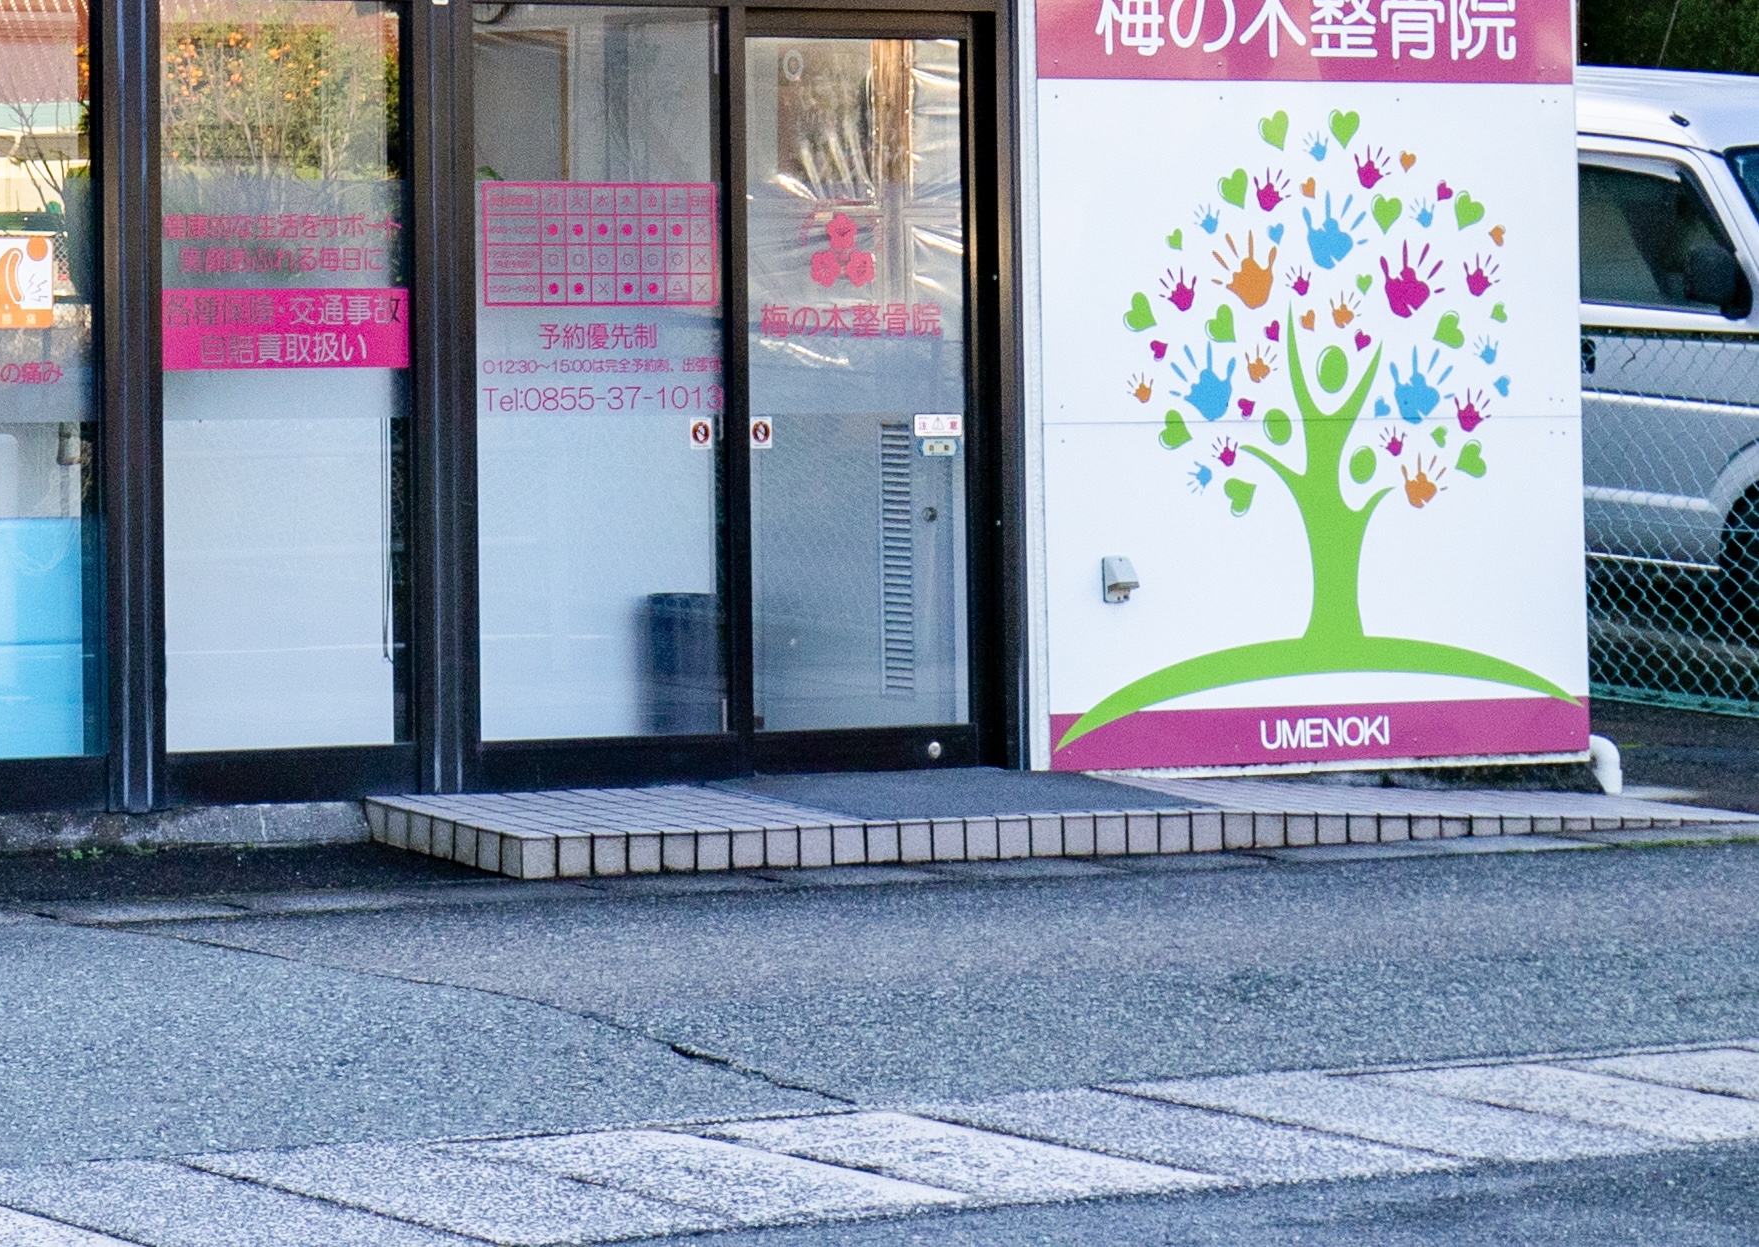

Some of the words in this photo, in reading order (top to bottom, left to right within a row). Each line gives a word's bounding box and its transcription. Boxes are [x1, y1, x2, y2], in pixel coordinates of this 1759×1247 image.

[538, 322, 658, 350] 予約優先制
[760, 303, 943, 338] 梅の木整骨院
[200, 332, 368, 365] 自賠責取扱い
[482, 385, 724, 412] Tel:0855-37-1013
[1260, 714, 1391, 750] UMENOKI
